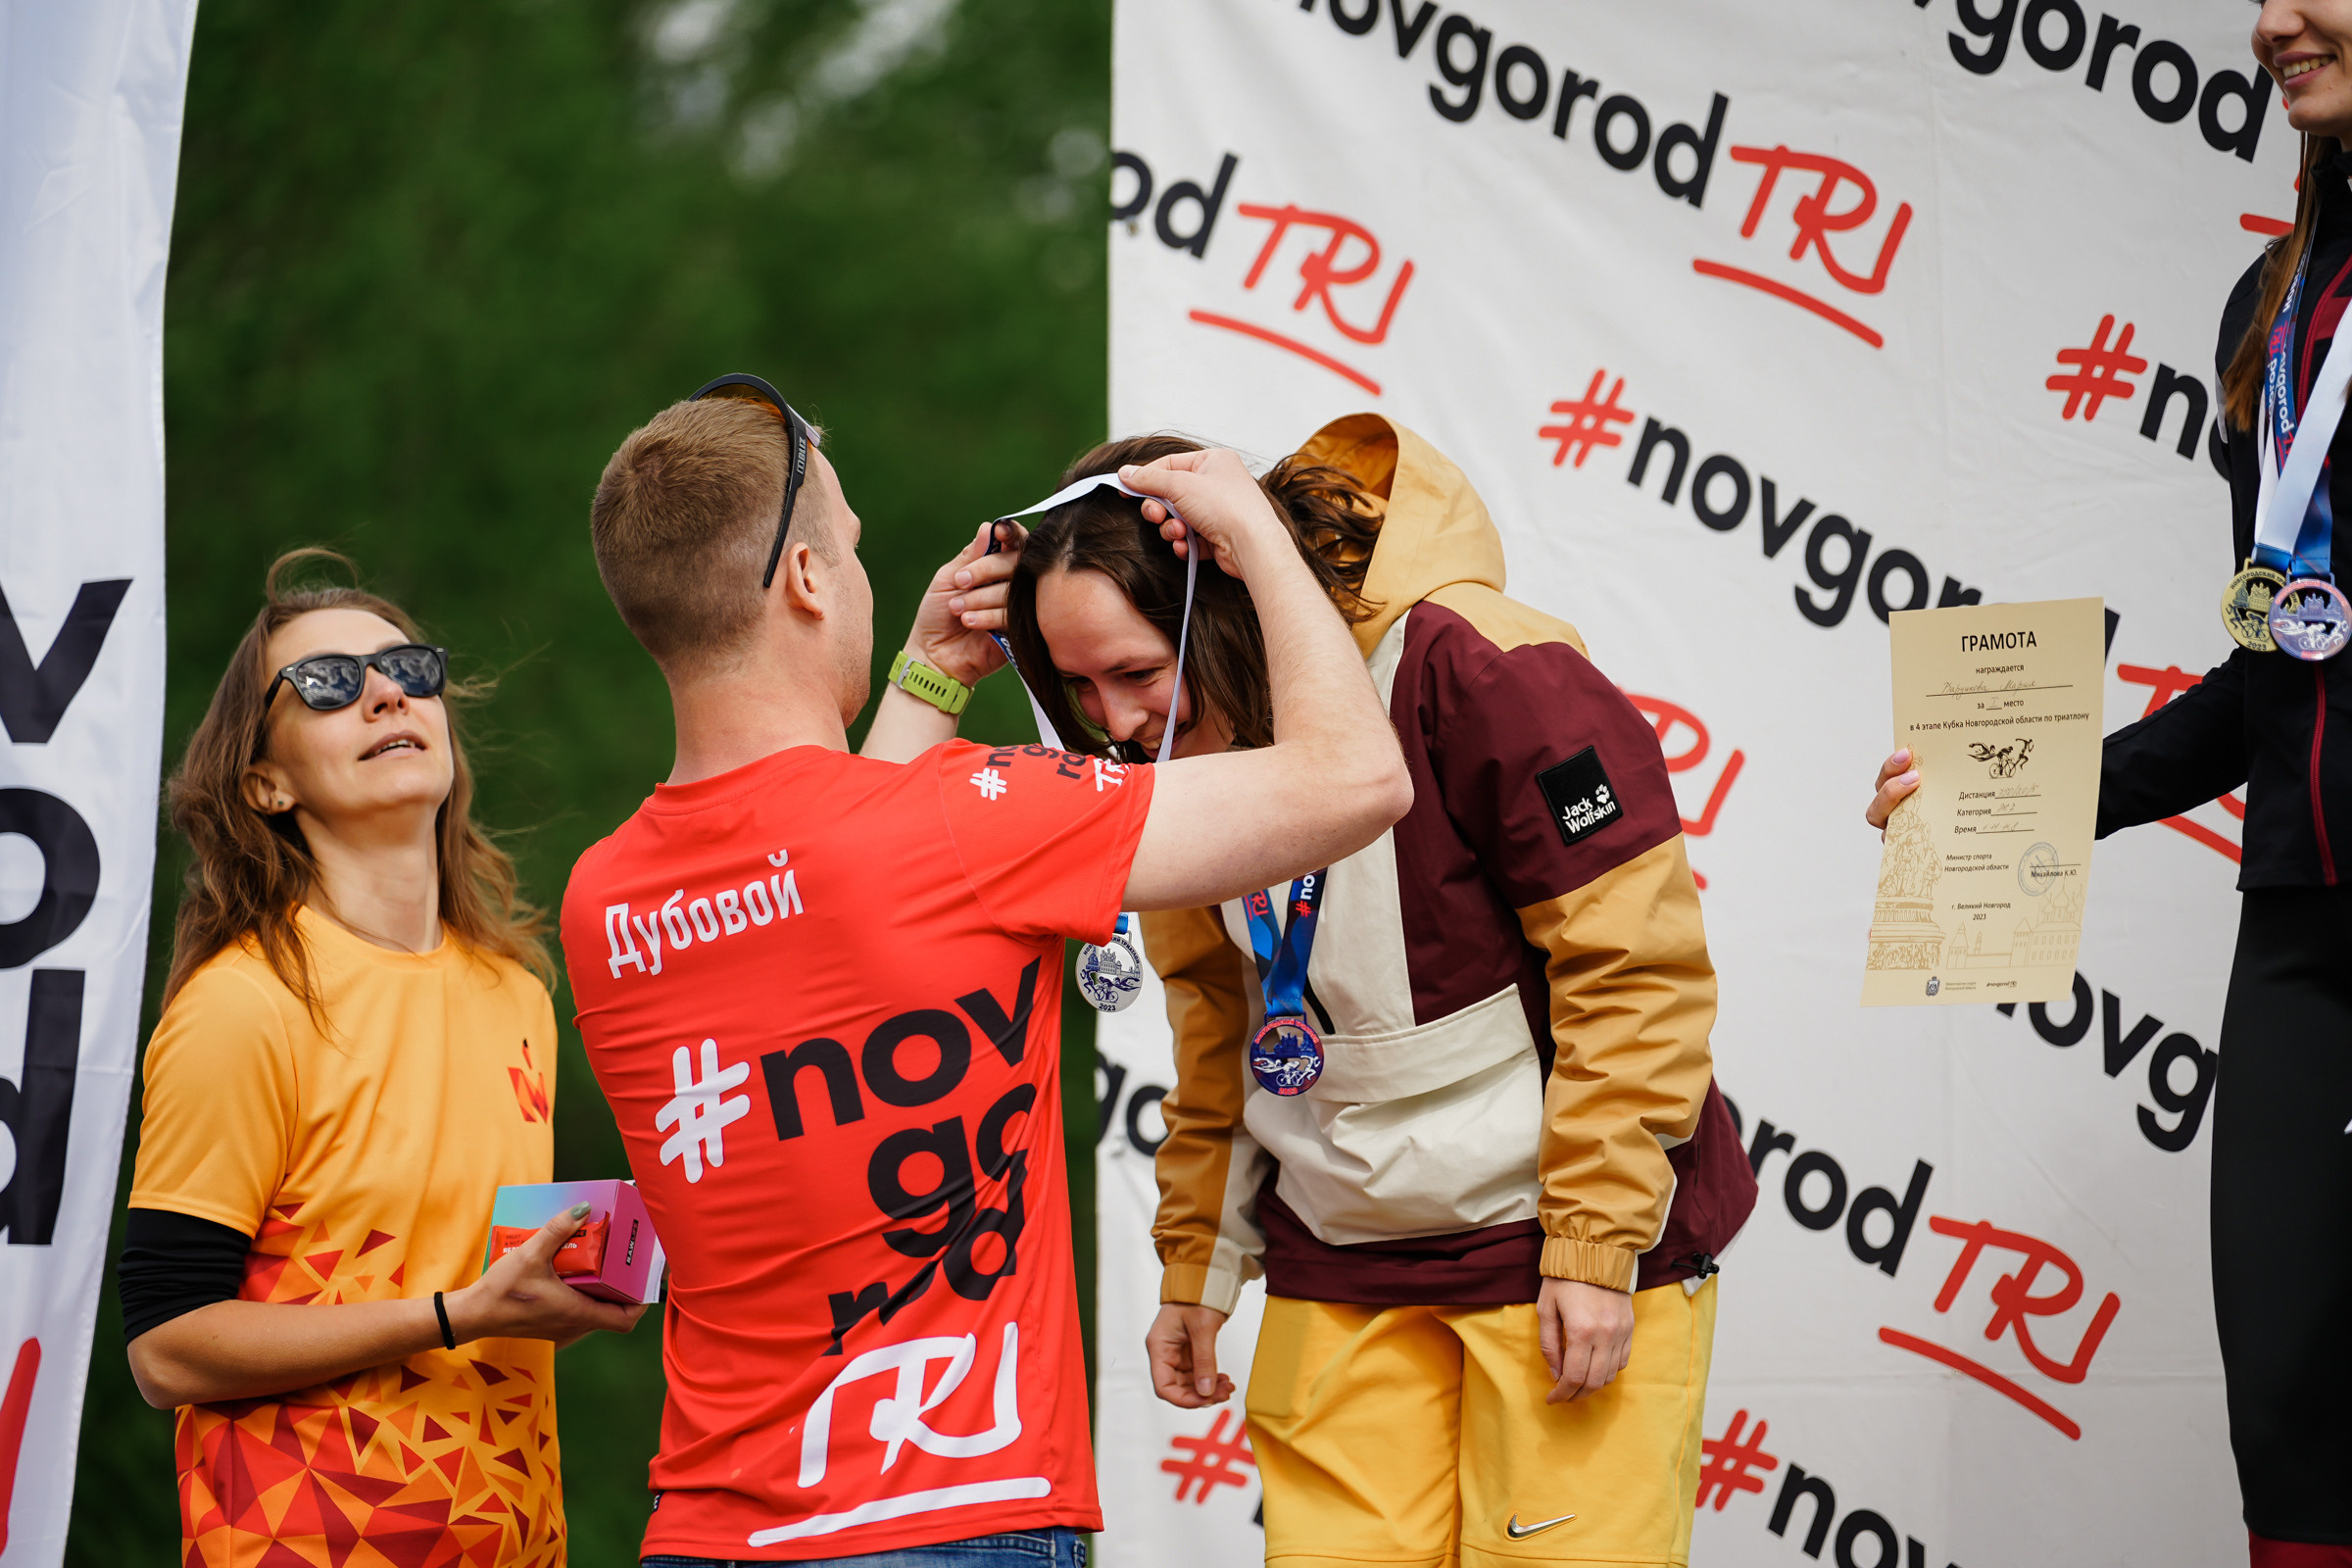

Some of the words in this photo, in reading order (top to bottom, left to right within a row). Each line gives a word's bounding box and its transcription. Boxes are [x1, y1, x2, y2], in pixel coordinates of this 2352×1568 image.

[1961, 630, 2037, 653] ГРАМОТА
[2246, 641, 2267, 651] 2023
[1976, 663, 2025, 675] награждается
[2003, 699, 2025, 708] место
[1922, 723, 1941, 732] этапе
[1942, 720, 1964, 731] Кубка
[1965, 716, 2014, 729] Новгородской
[2016, 714, 2042, 724] области
[2054, 712, 2089, 722] триатлону
[1959, 791, 1996, 801] Дистанция
[1562, 797, 1593, 820] Jack
[1956, 808, 1992, 817] Категория
[1565, 801, 1616, 834] Wolfskin
[1954, 825, 1977, 835] Время
[1944, 864, 1985, 873] Новгородской
[1957, 902, 1983, 910] Великий
[1983, 902, 2011, 910] Новгород
[604, 849, 805, 979] Дубовой
[1121, 939, 1141, 964] ТРИАТЛОН
[655, 955, 1042, 1184] #nov
